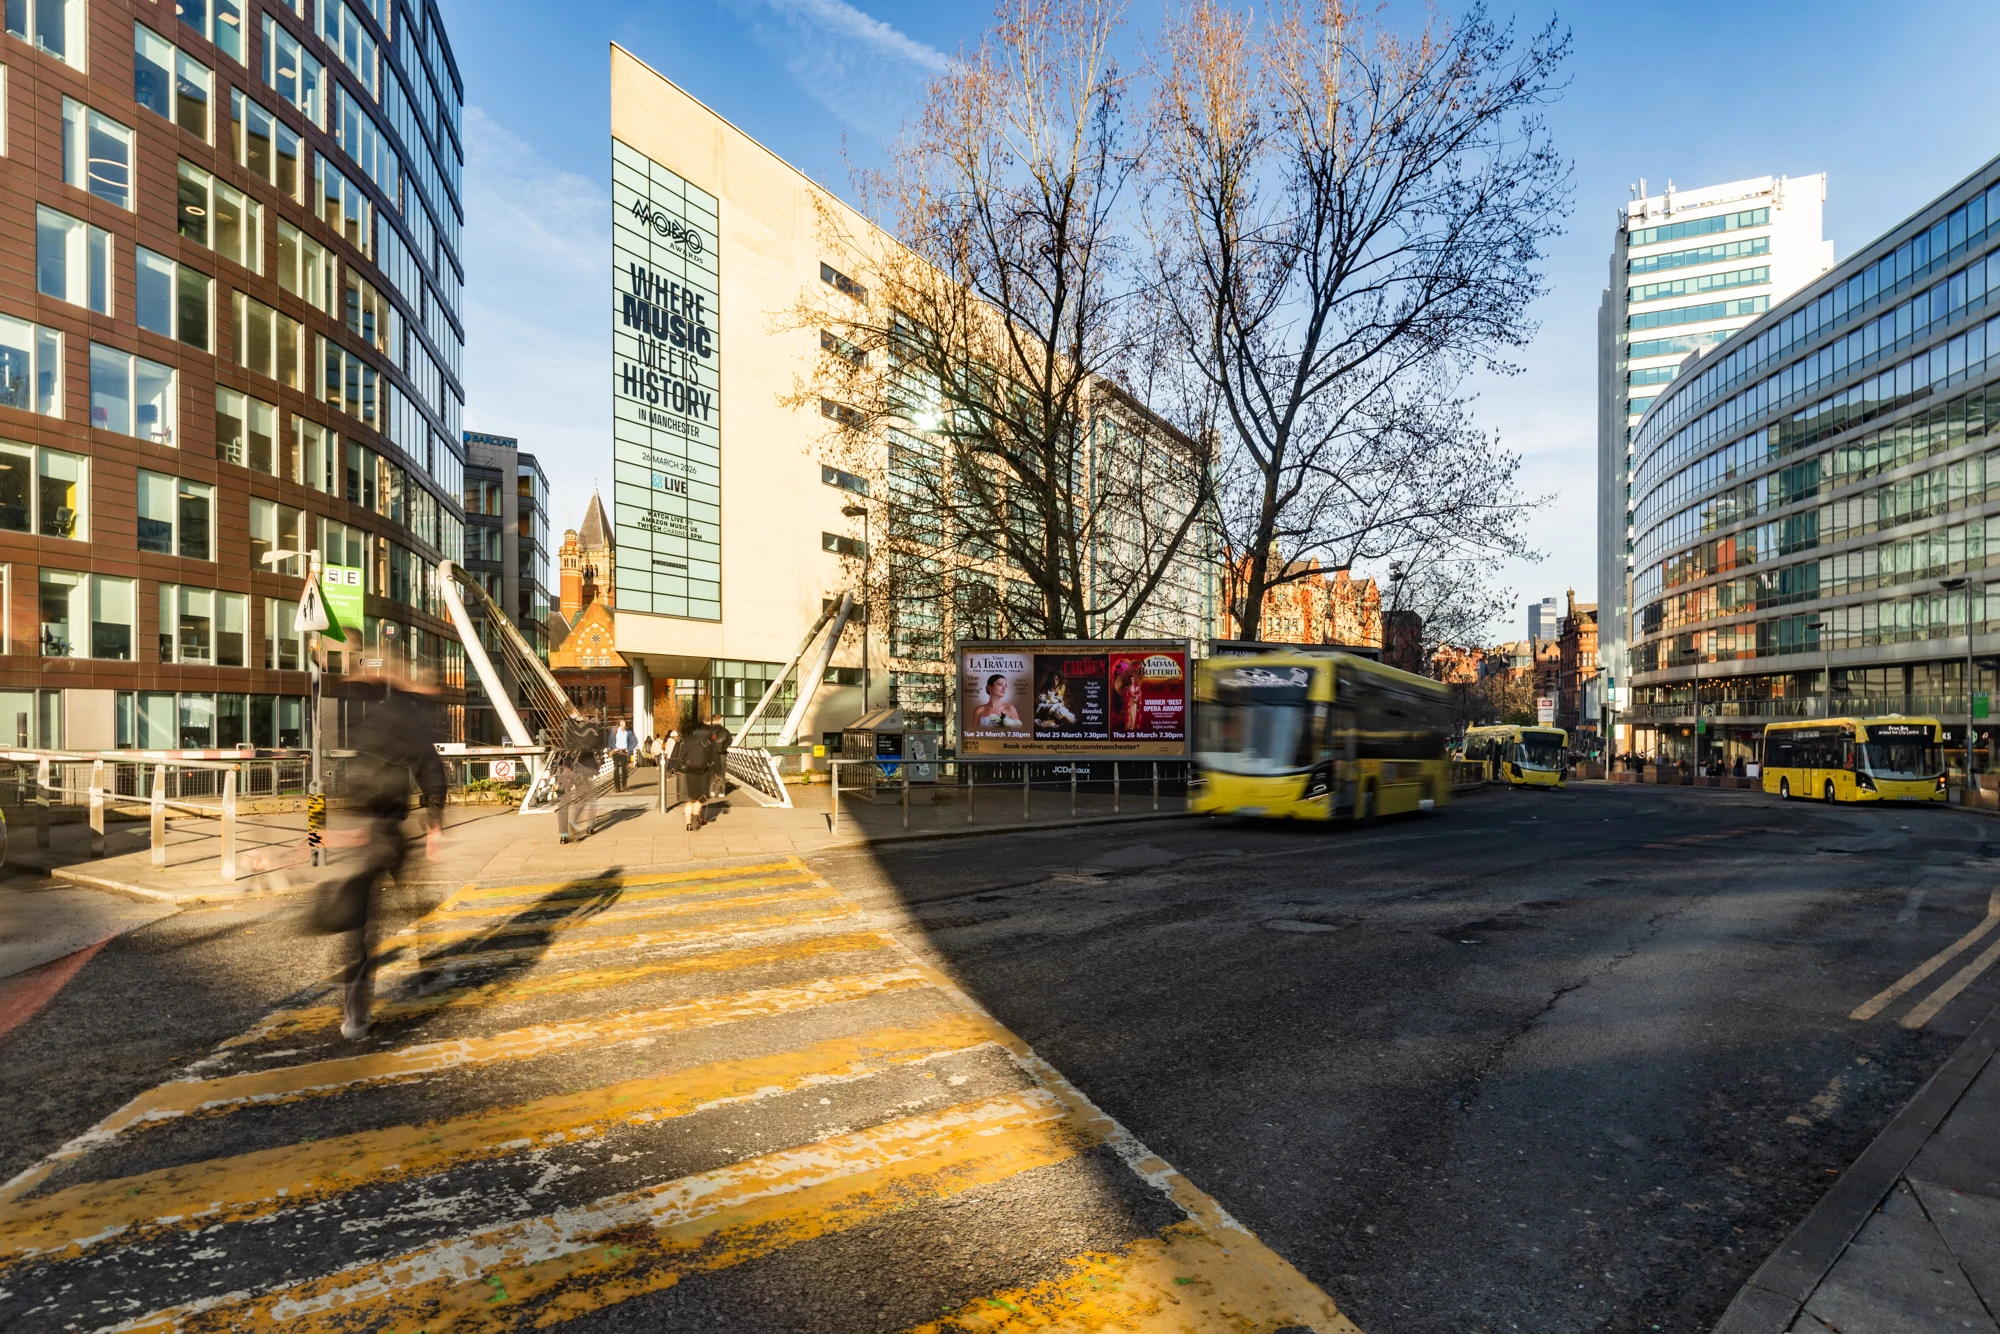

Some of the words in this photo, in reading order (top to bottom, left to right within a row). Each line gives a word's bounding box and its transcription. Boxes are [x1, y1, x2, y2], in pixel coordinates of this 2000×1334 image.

[632, 198, 702, 254] MOBO
[670, 242, 704, 264] AWARDS
[630, 262, 705, 326] WHERE
[623, 292, 712, 359] MUSIC
[638, 334, 698, 386] MEETS
[623, 362, 712, 422] HISTORY
[638, 408, 646, 421] IN
[649, 411, 700, 438] MANCHESTER
[472, 434, 518, 448] BARCLAYS
[642, 452, 651, 462] 26
[652, 455, 679, 470] MARCH
[680, 463, 697, 474] 2026
[665, 476, 687, 494] LIVE
[642, 516, 668, 526] AMAZON
[670, 522, 688, 530] MUSIC
[647, 510, 669, 520] WATCH
[637, 522, 661, 531] TWITCH
[348, 572, 356, 584] E
[982, 658, 1024, 668] TRAVIATA
[1063, 660, 1106, 675] CARMEN
[1141, 659, 1181, 667] MADAMA
[1924, 726, 1928, 735] 1
